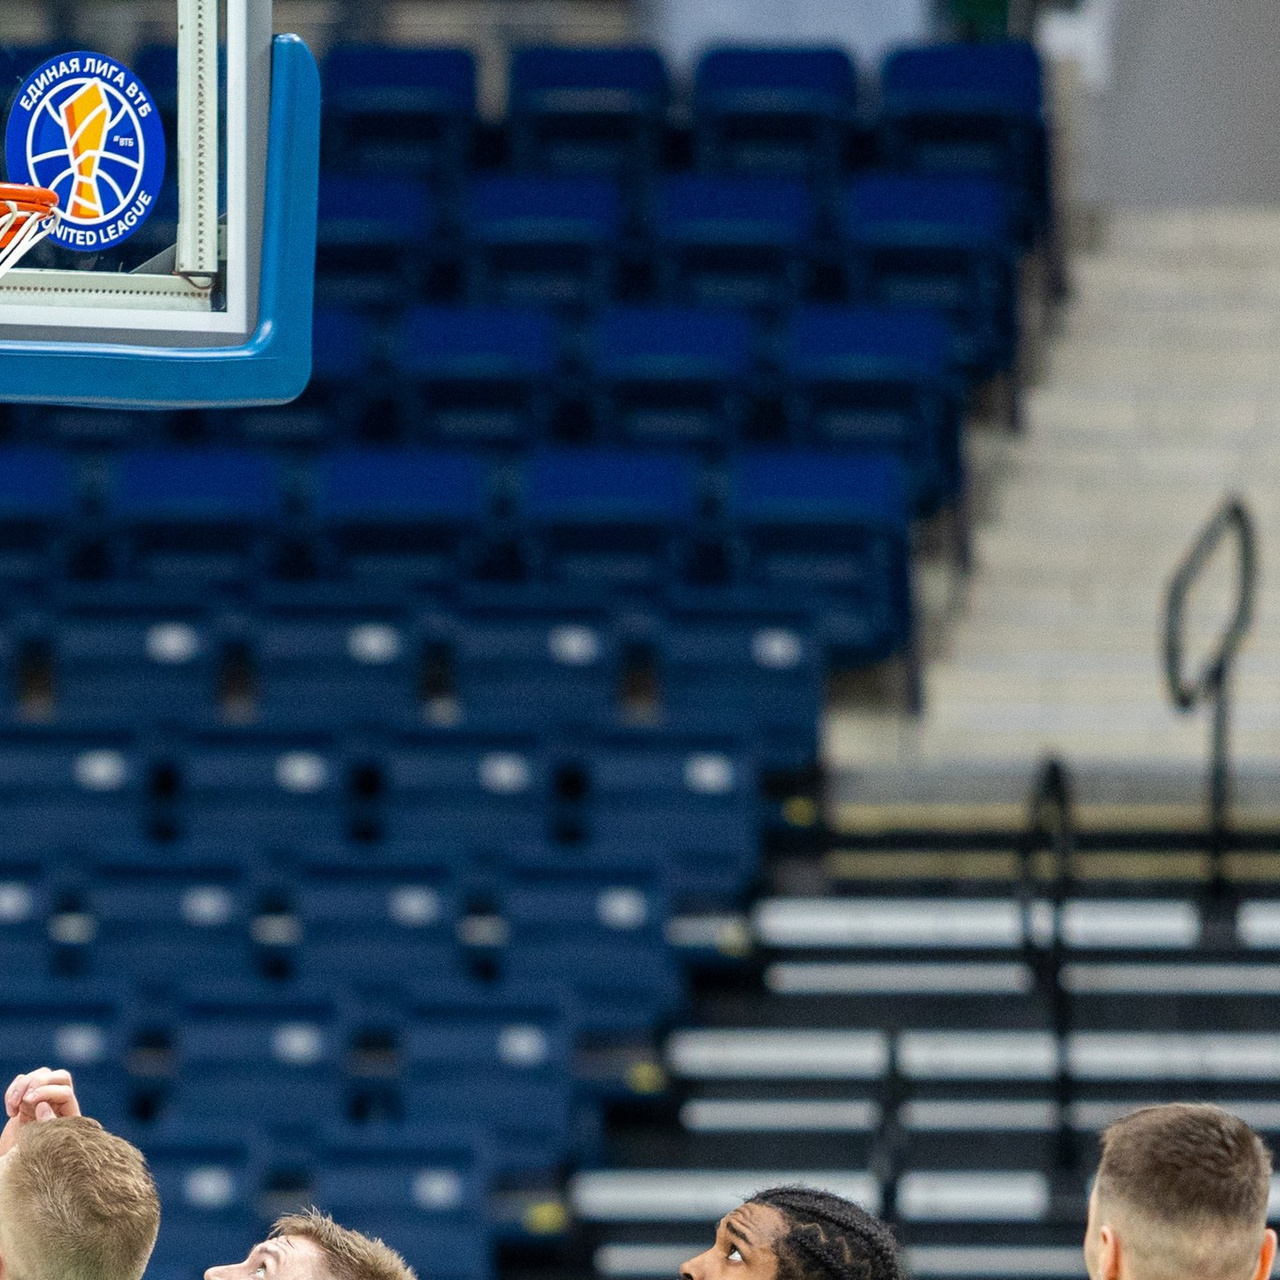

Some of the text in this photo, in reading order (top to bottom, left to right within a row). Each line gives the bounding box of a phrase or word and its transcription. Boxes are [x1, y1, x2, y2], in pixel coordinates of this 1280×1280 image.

[20, 57, 152, 118] ЕДИНАЯ ЛИГА ВТБ
[99, 190, 152, 244] LEAGUE
